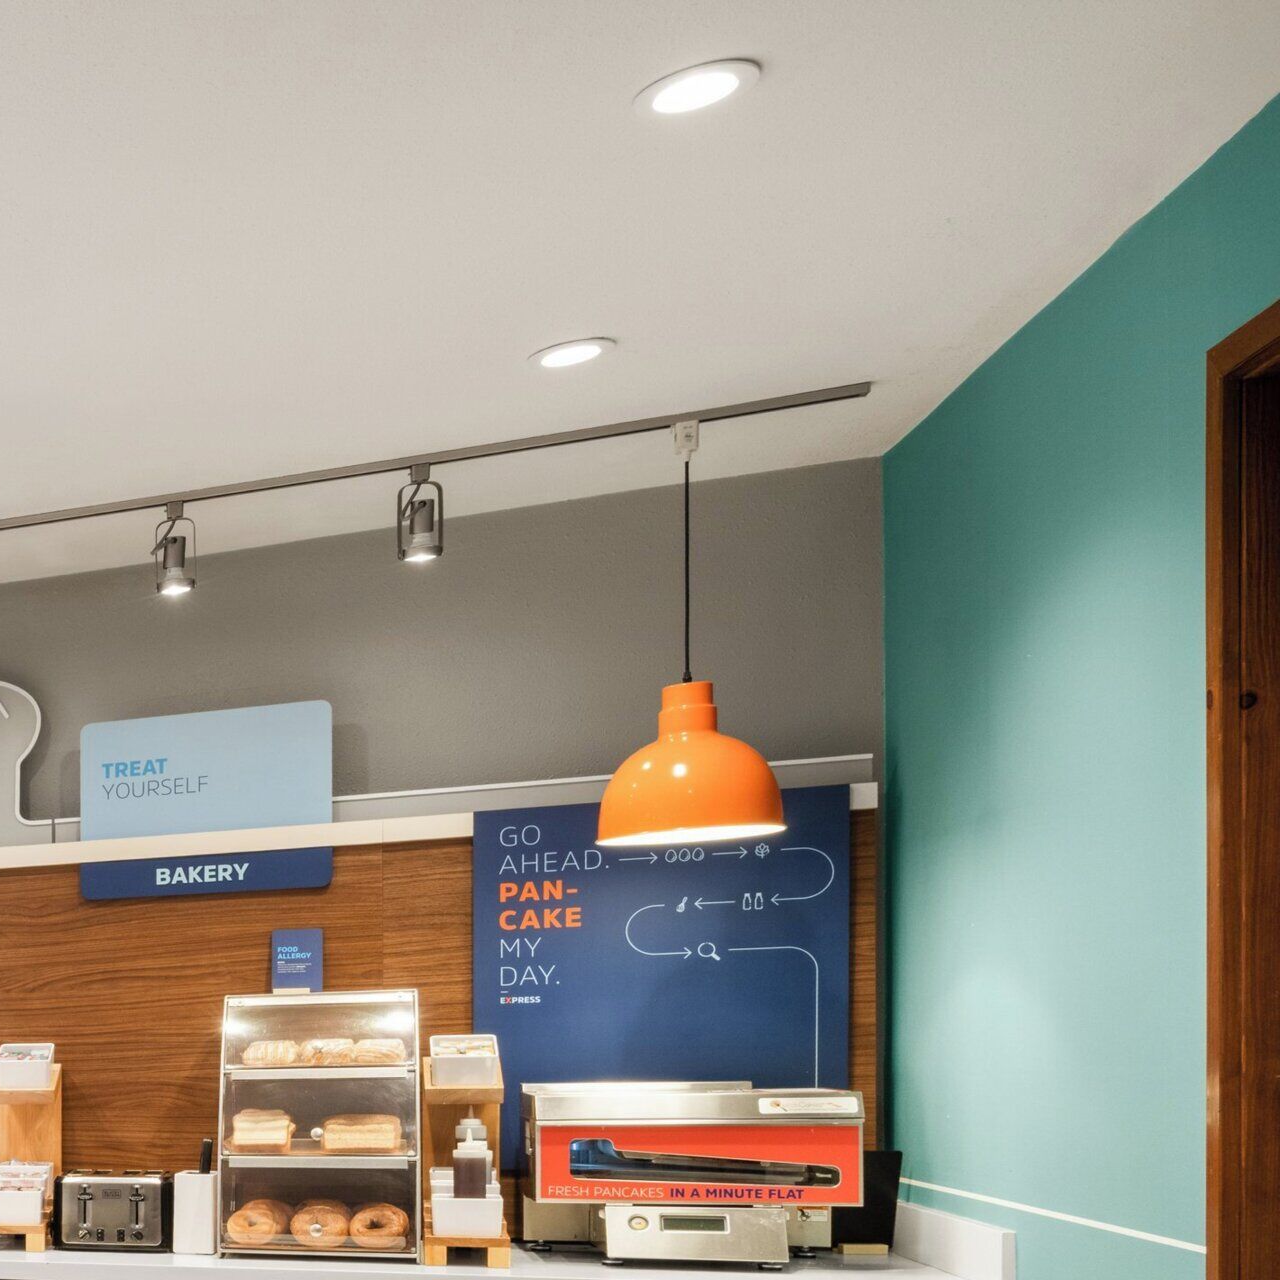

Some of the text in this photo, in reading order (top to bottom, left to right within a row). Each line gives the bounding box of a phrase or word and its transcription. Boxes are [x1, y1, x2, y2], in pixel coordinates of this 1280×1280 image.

[101, 757, 169, 780] TREAT
[101, 774, 209, 801] YOURSELF
[499, 825, 541, 847] GO
[154, 861, 251, 886] BAKERY
[499, 849, 610, 875] AHEAD.
[499, 879, 578, 903] PAN-
[498, 907, 582, 931] CAKE
[277, 952, 312, 960] ALLERGY
[500, 936, 542, 959] MY
[500, 964, 561, 987] DAY.
[500, 995, 541, 1004] EXPRESS
[547, 1185, 805, 1200] FRESH PANCAKES IN A MINUTE FLAT
